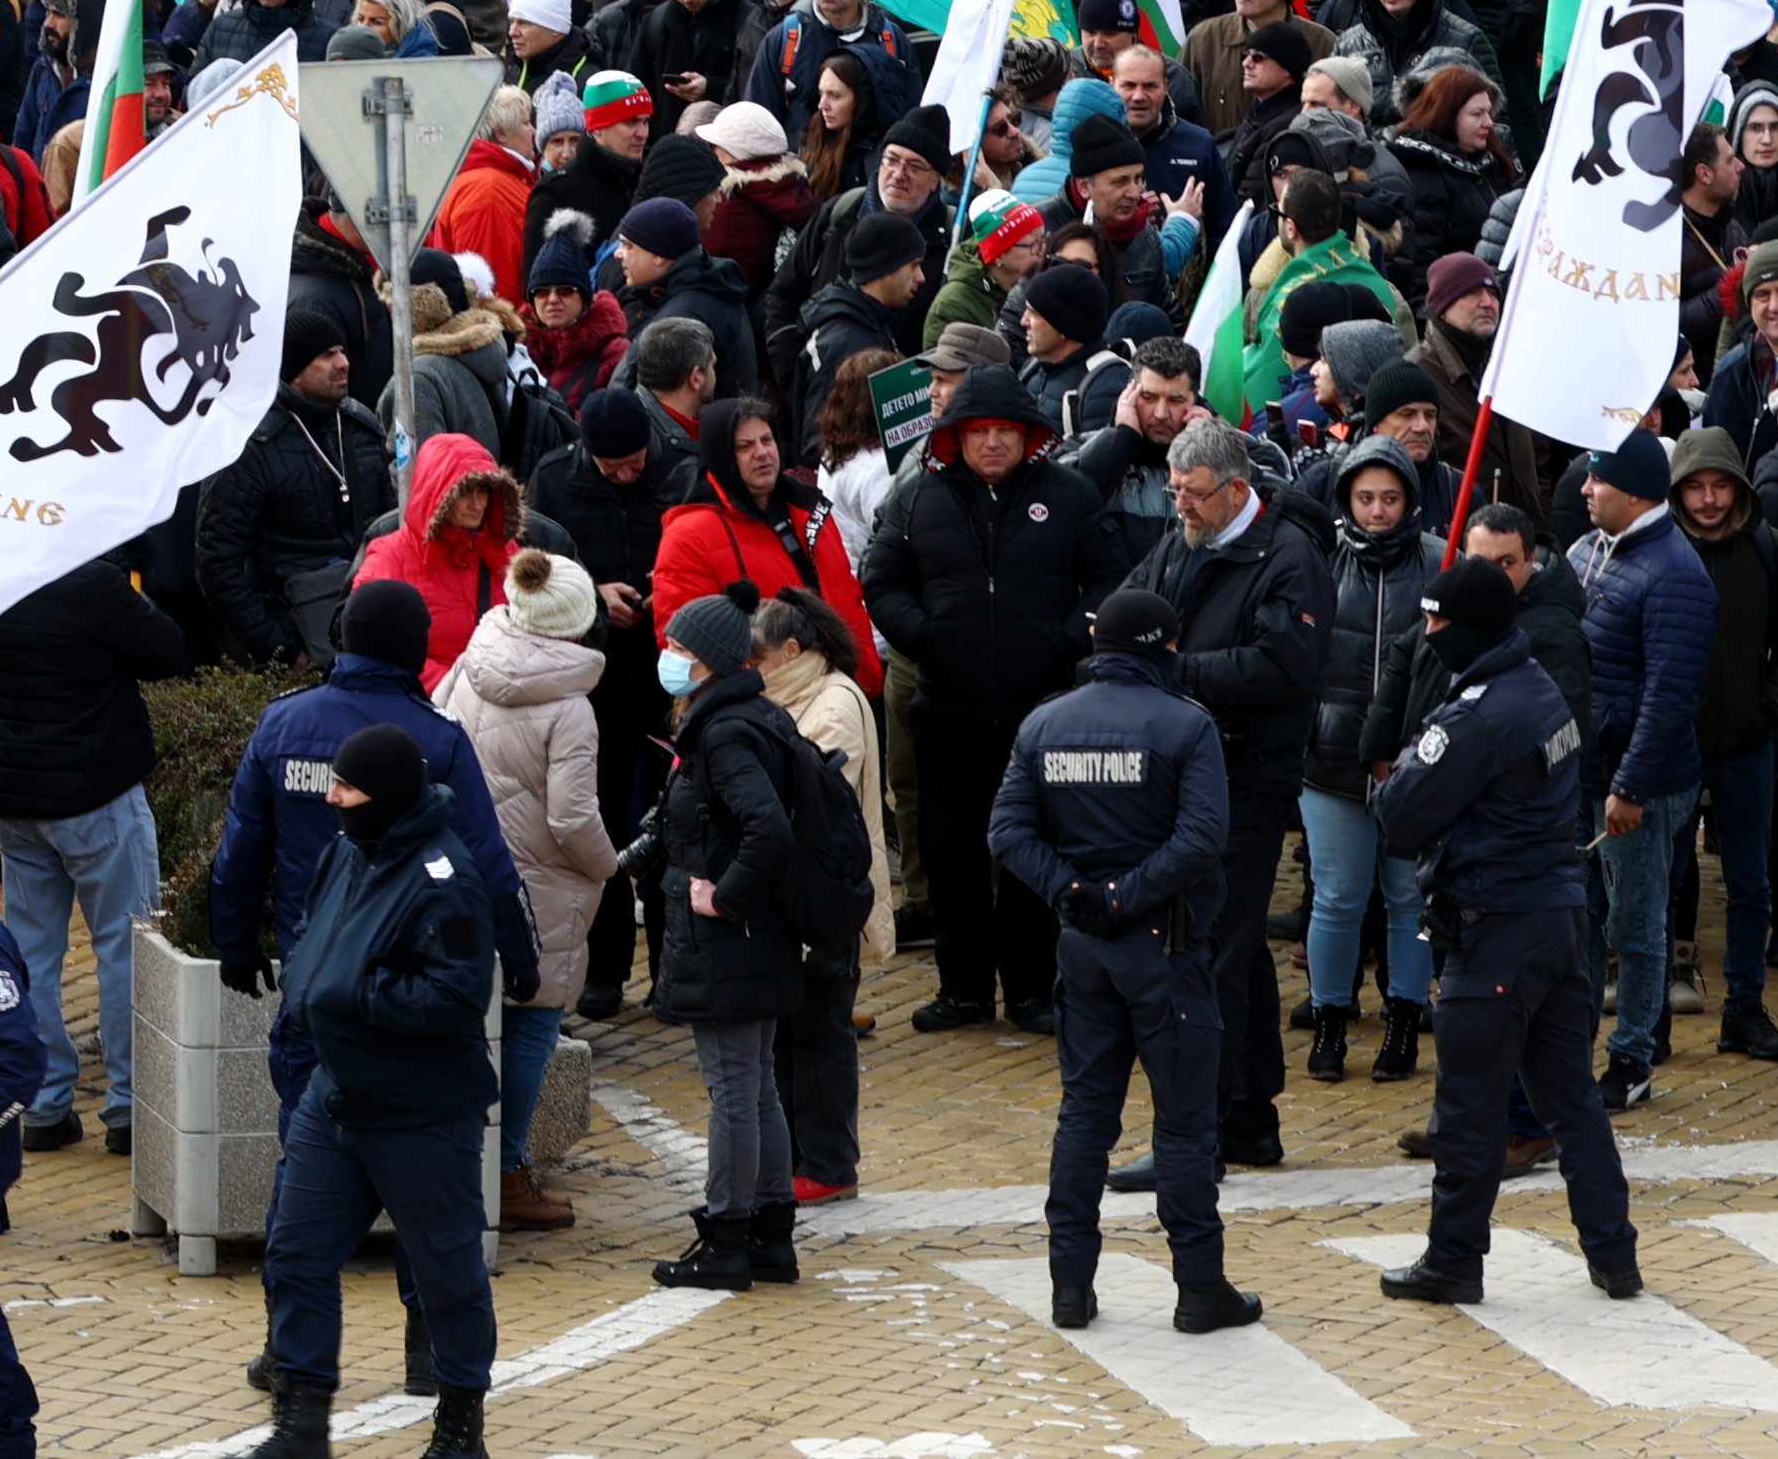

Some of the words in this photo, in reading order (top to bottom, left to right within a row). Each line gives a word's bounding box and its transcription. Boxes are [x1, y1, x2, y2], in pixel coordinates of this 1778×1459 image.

[881, 392, 915, 420] ДЕТЕТО
[887, 430, 901, 446] НА
[1044, 751, 1101, 783] SECURITY
[1103, 751, 1142, 783] POLICE
